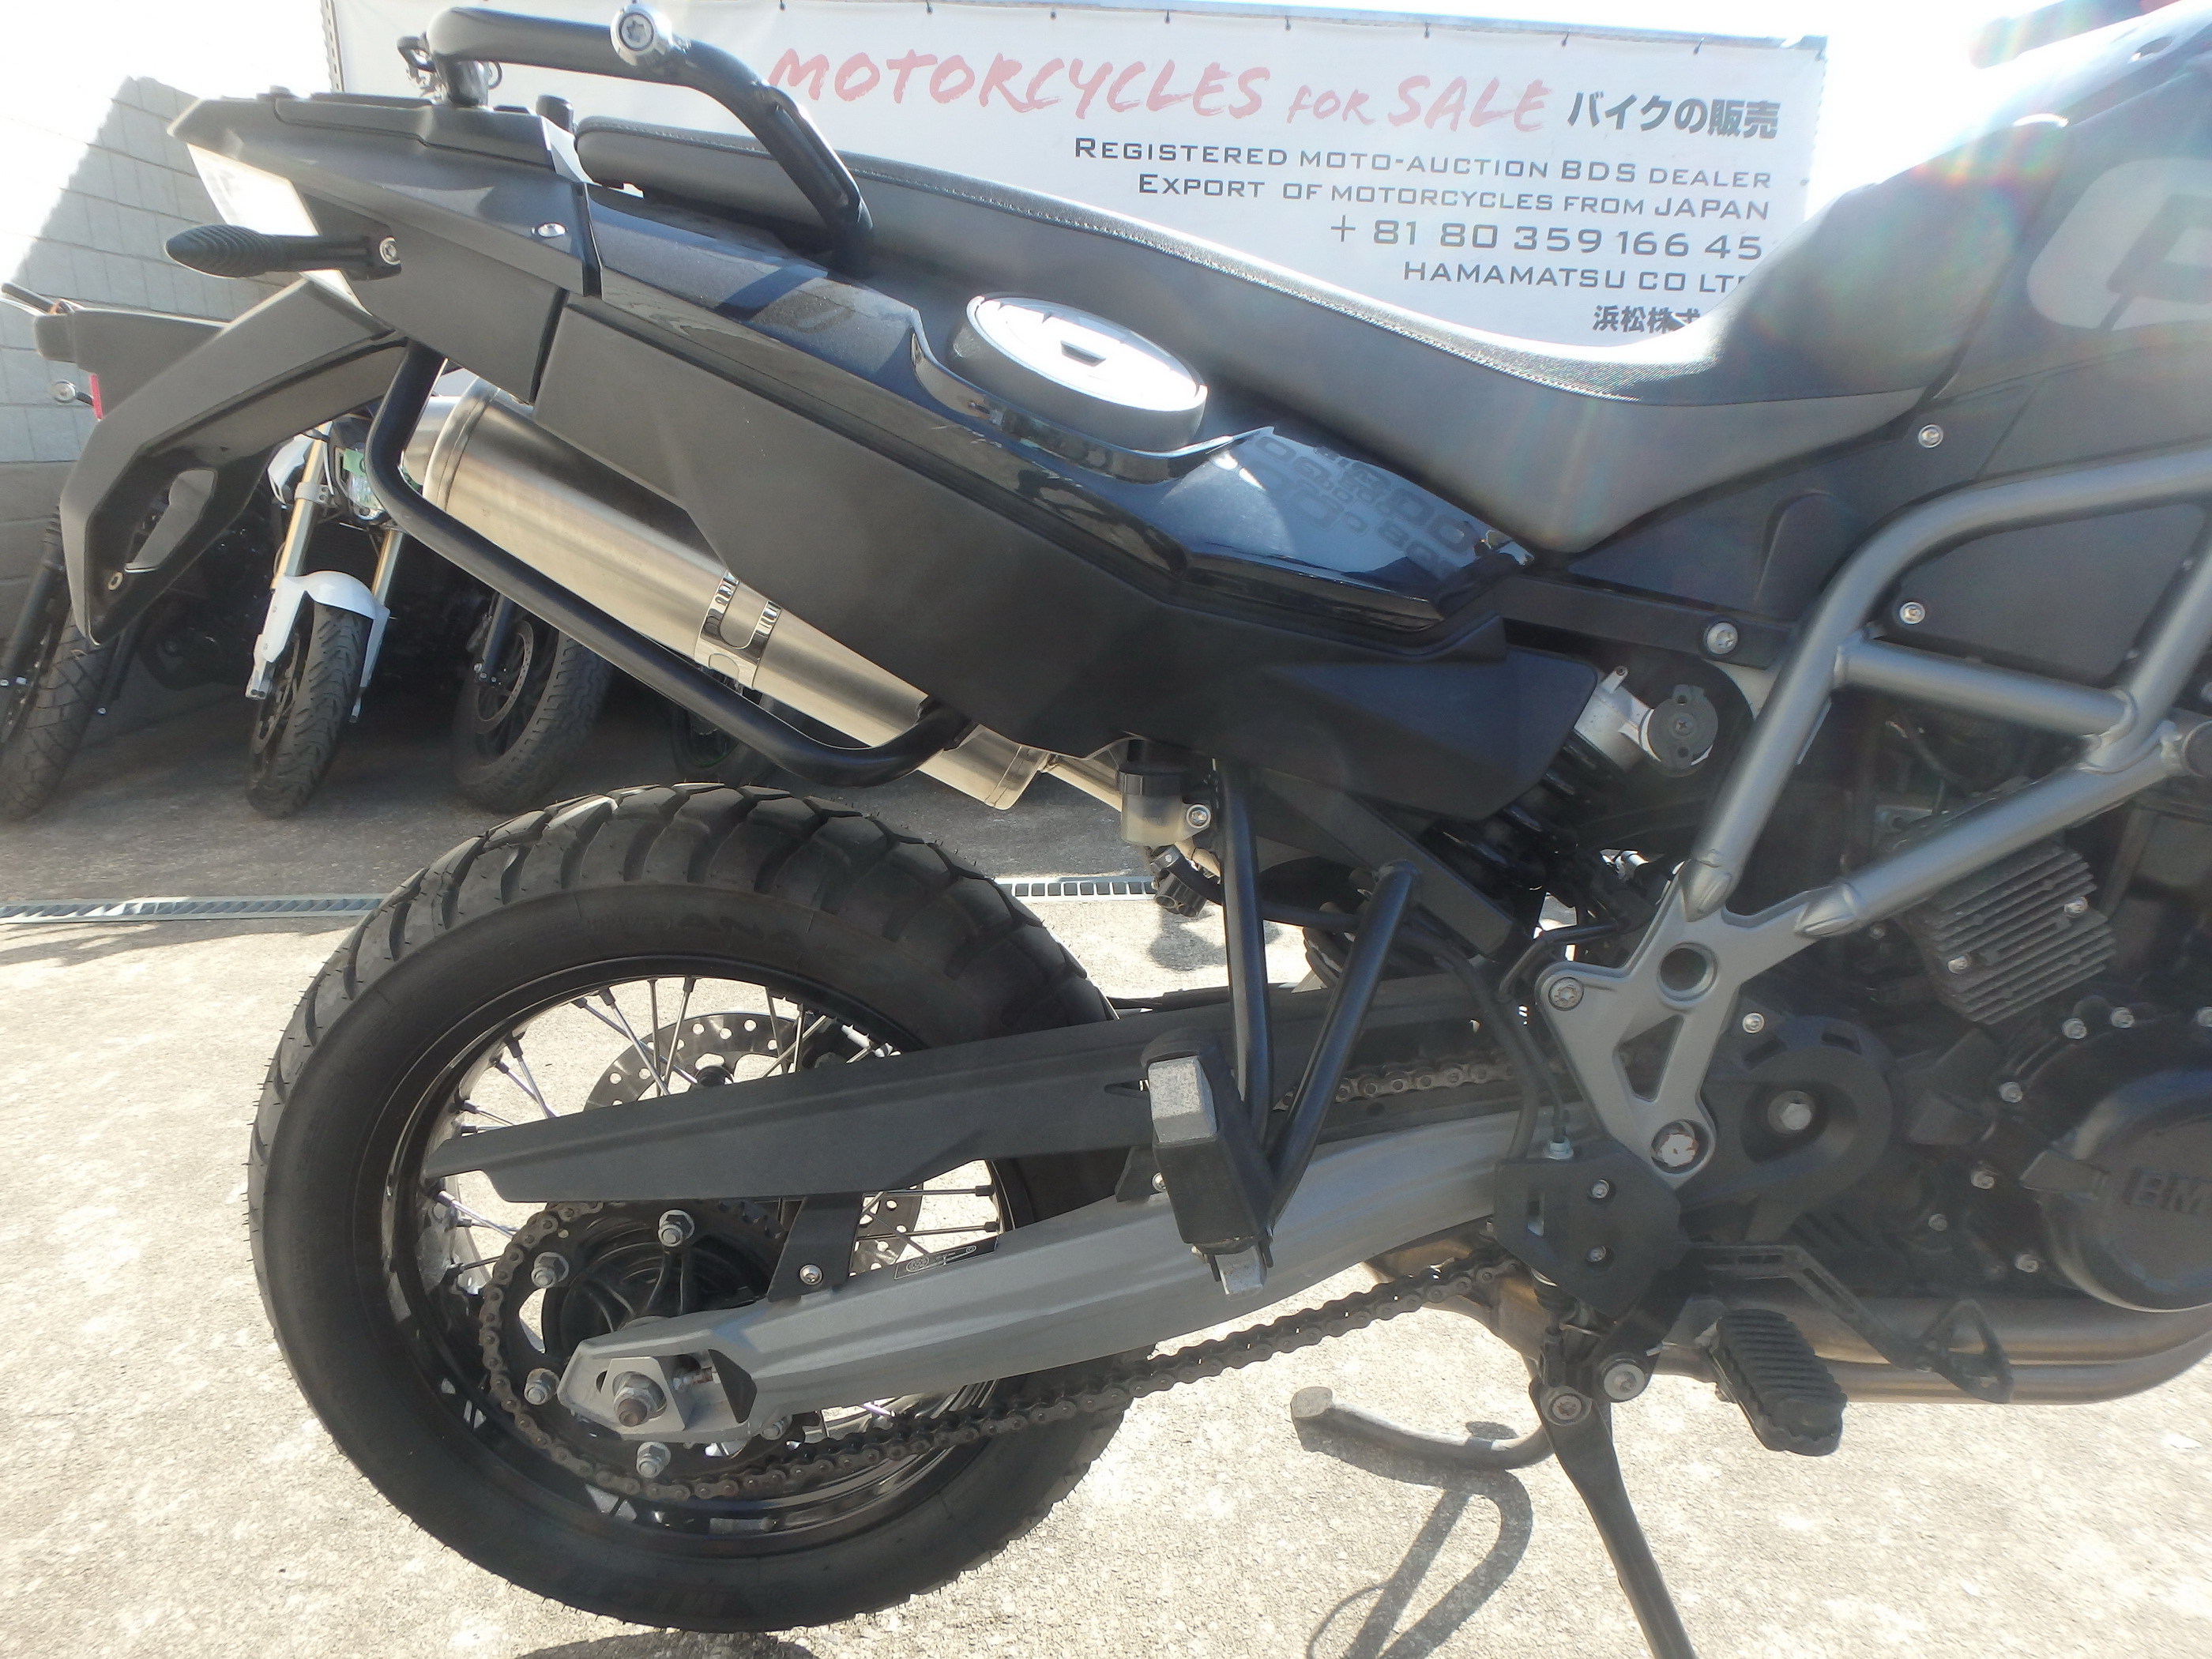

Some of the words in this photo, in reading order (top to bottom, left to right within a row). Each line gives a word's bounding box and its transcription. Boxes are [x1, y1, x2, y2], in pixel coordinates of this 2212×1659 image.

[766, 48, 1271, 119] MOTORCYCLES
[1388, 76, 1552, 133] SALE
[1567, 91, 1781, 139] バイクの販売
[1075, 137, 1288, 166] REGISTERED
[1300, 149, 1548, 179] MOTO-AUCTION
[1561, 160, 1636, 182] BDS
[1649, 167, 1771, 188] DEALER
[1138, 172, 1266, 198] EXPORT
[1282, 182, 1322, 201] OF
[1331, 185, 1553, 211] MOTORCYCLES
[1563, 195, 1644, 215] FROM
[1654, 197, 1769, 220] JAPAN
[1373, 220, 1416, 246] 81
[1440, 222, 1499, 249] 80
[1704, 235, 1762, 260] 45
[1404, 261, 1626, 289] HAMAMATSU
[1638, 271, 1687, 292] CO
